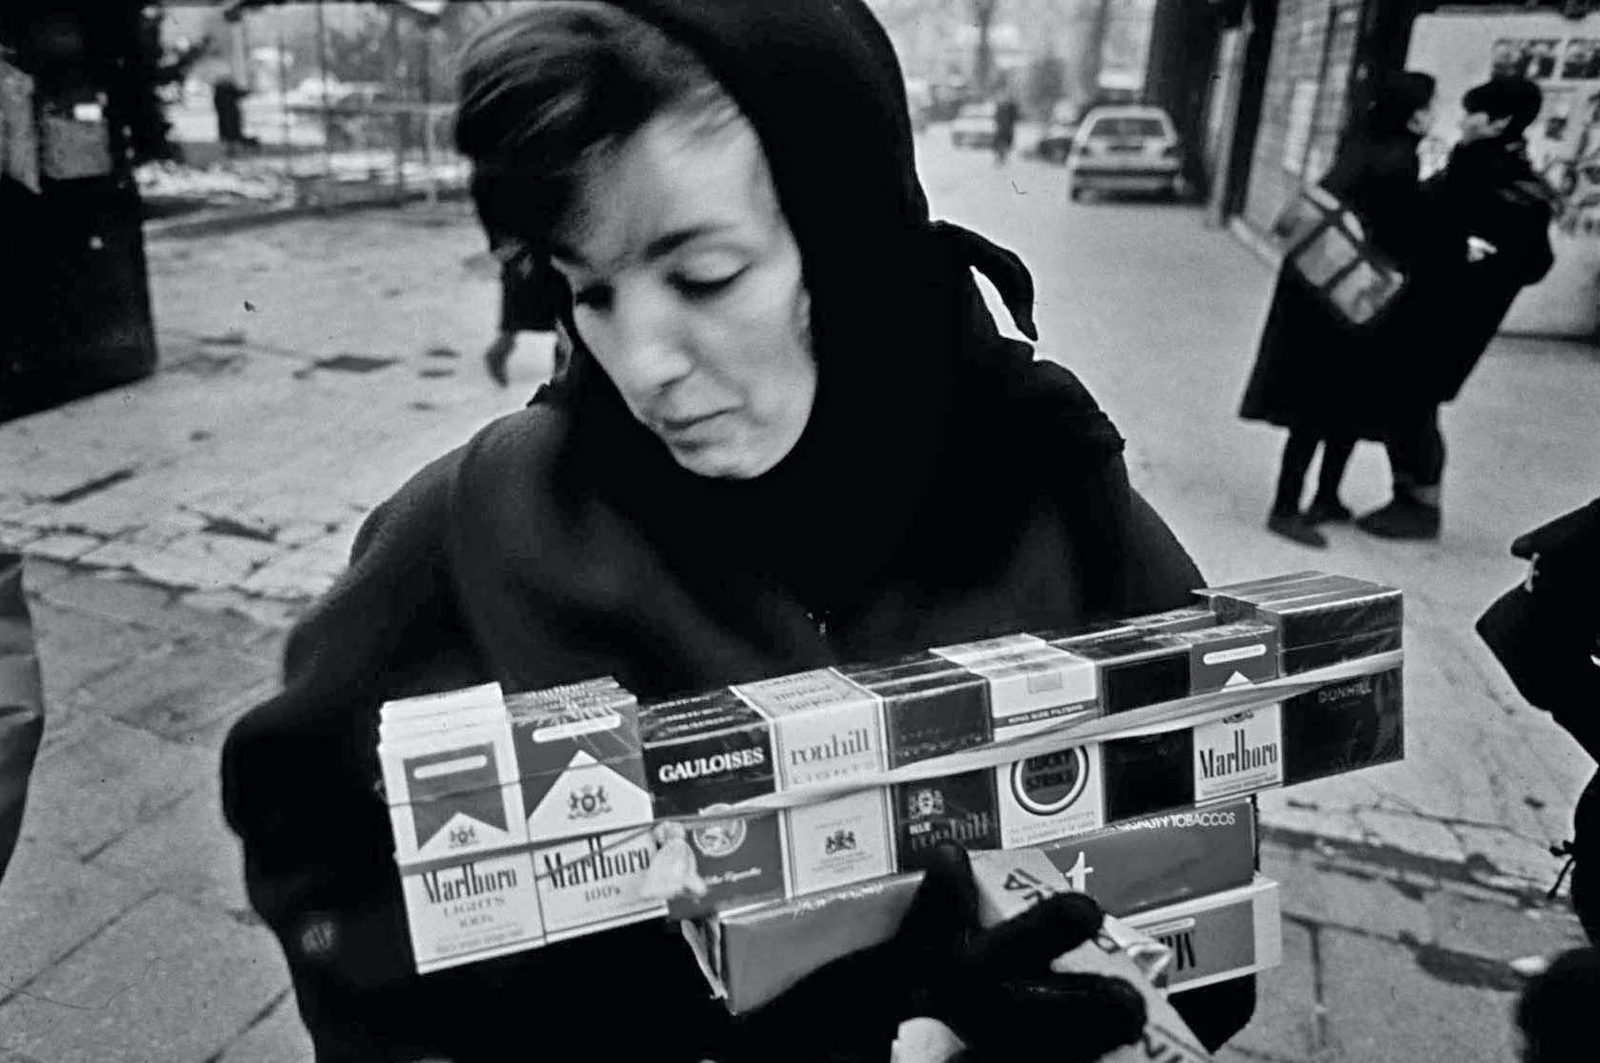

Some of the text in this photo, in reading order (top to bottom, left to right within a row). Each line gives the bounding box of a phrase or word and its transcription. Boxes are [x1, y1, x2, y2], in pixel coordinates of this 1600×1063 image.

[658, 746, 765, 783] GAULOISES
[790, 728, 870, 766] ronhill
[1199, 728, 1278, 779] Marlboro
[1170, 811, 1237, 828] TOBACCOS
[543, 836, 651, 889] Marlboro
[420, 863, 518, 904] Marlboro
